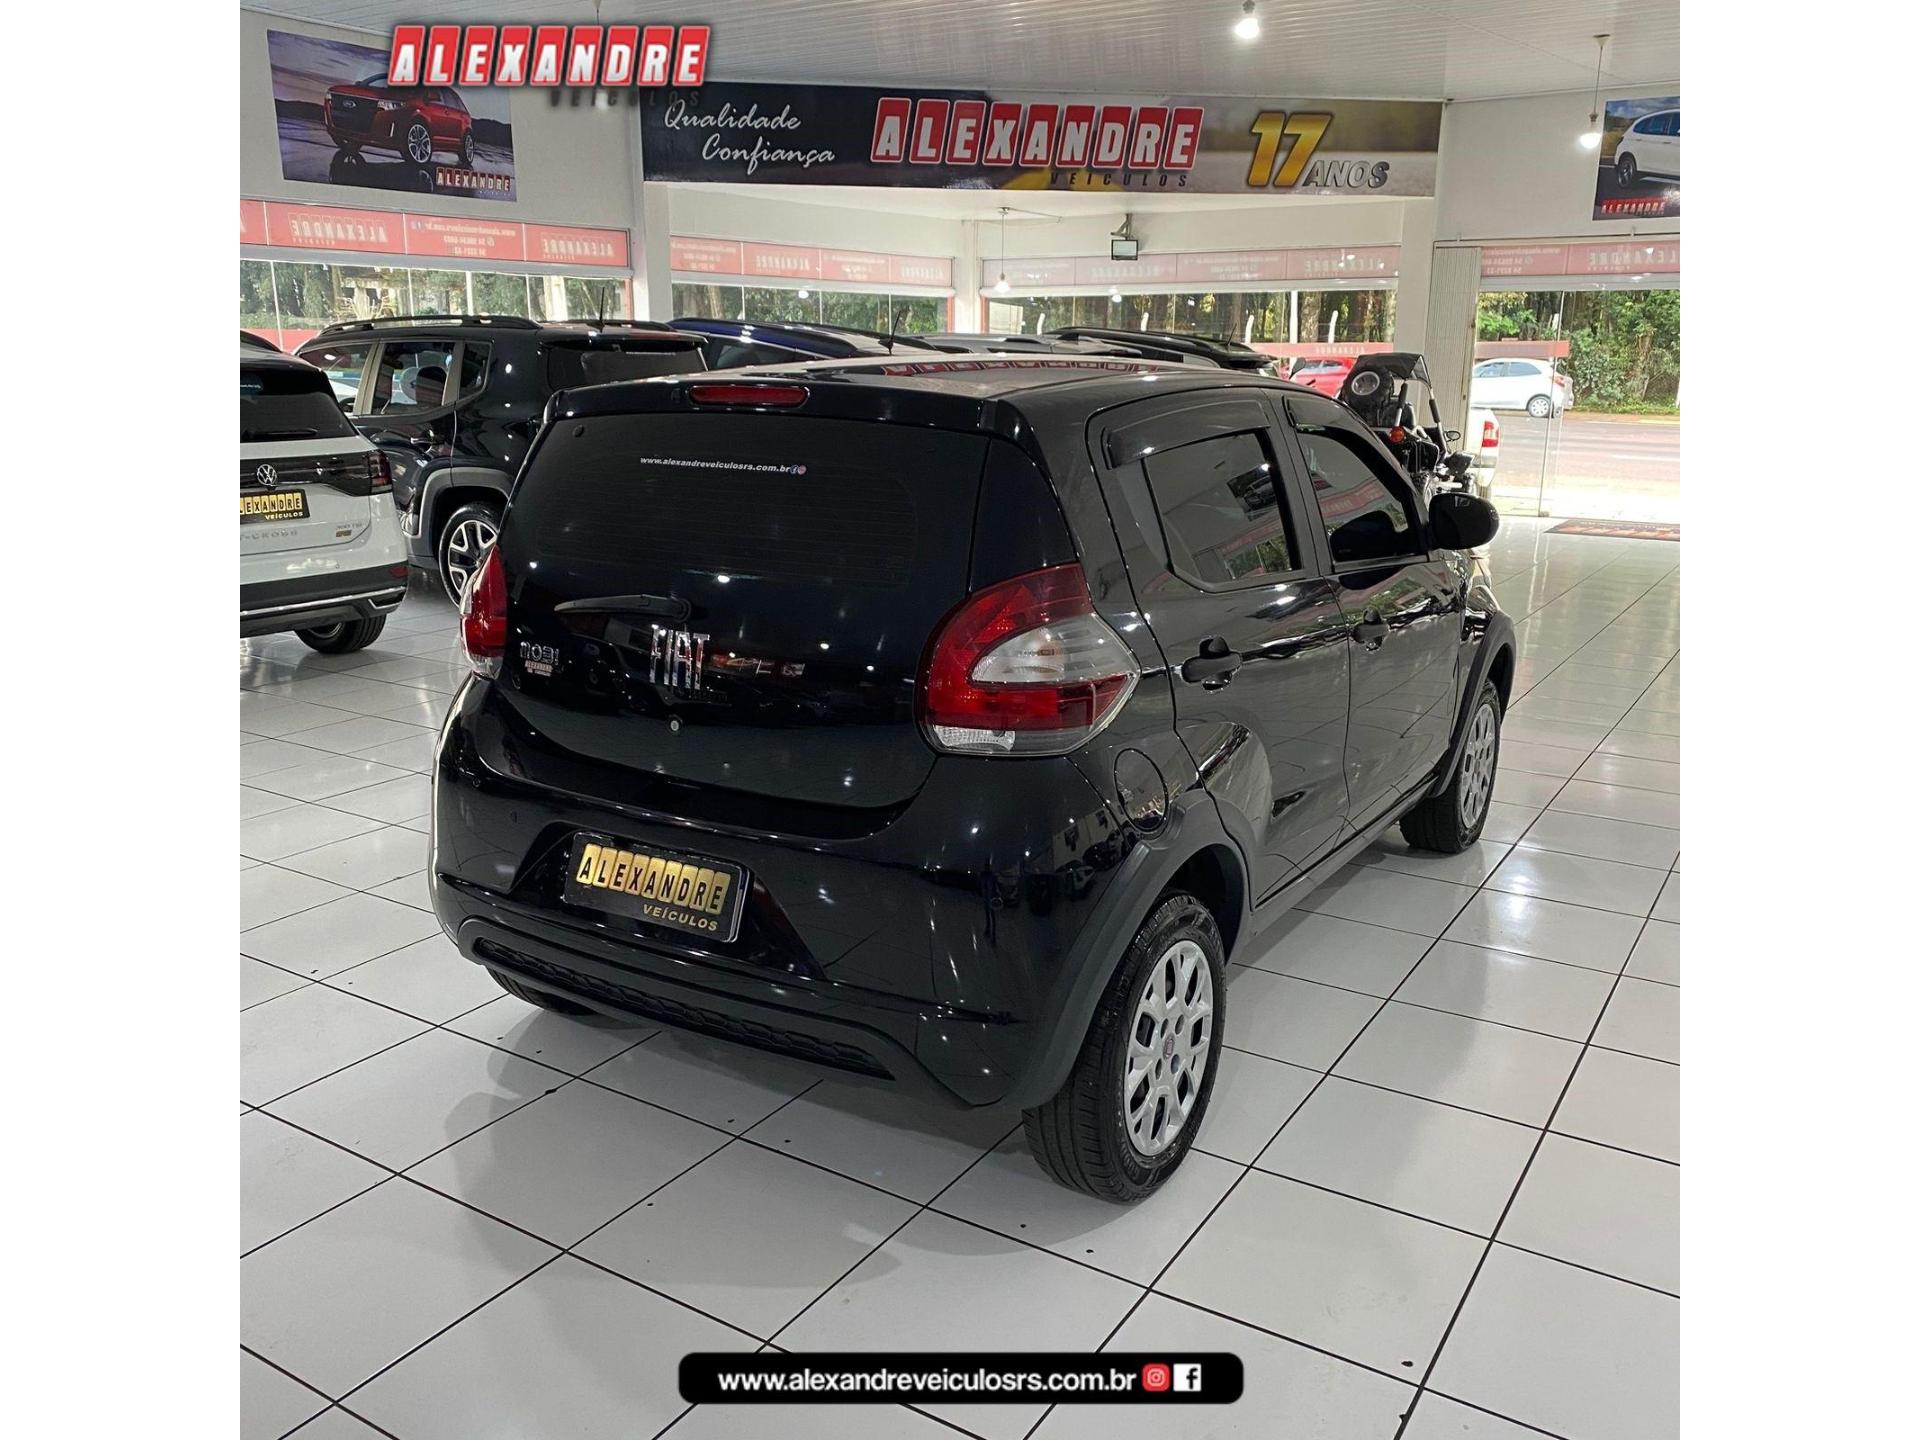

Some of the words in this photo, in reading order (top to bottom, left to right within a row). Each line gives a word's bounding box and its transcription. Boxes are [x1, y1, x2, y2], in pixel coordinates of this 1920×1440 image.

[664, 99, 801, 131] Qualidade
[702, 132, 835, 175] Confiança
[876, 115, 1197, 166] ALEXANDRE
[1247, 111, 1335, 187] 17
[1302, 160, 1390, 190] ANOS
[437, 172, 511, 191] ALEXANDRE
[1050, 172, 1187, 187] VEICULOS
[639, 456, 790, 474] www.alexandreveiculosrs.com.br
[649, 625, 710, 690] FIAT
[579, 857, 723, 911] ALEXANDRE
[643, 903, 718, 932] VEÍCULOS
